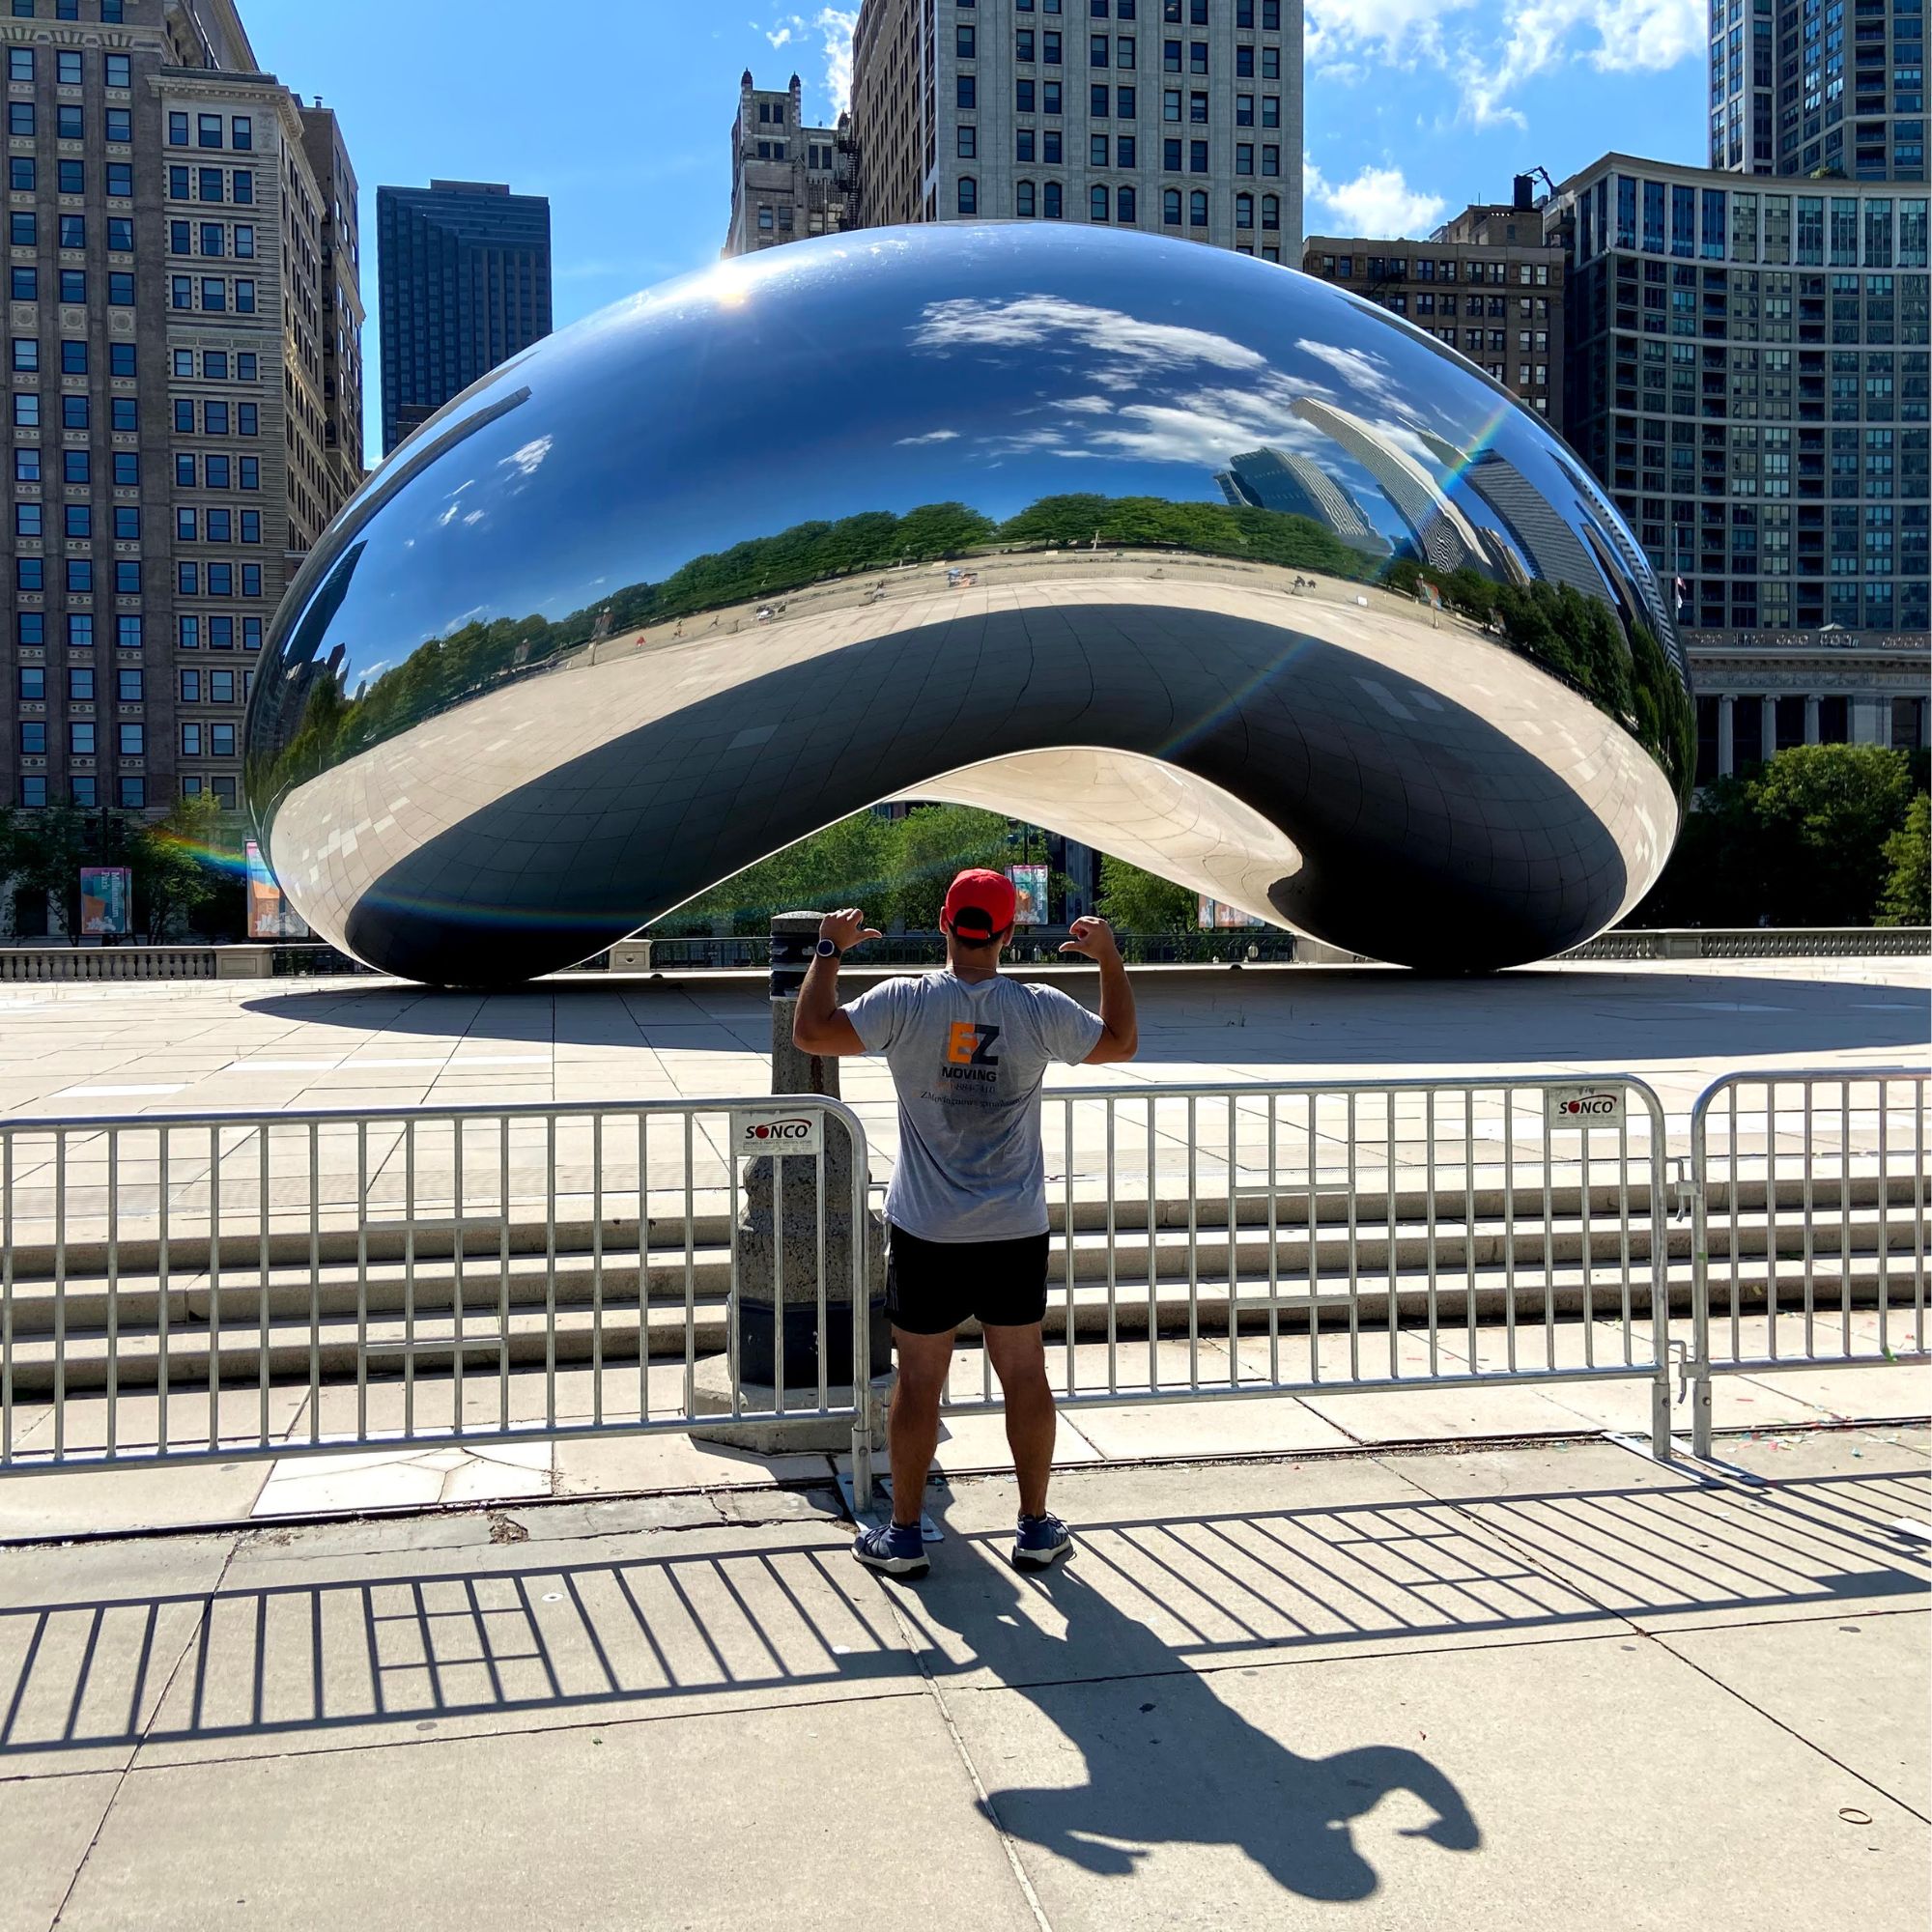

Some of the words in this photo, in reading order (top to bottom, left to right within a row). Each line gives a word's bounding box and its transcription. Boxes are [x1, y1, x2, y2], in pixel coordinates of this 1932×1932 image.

[100, 871, 110, 890] Park
[111, 871, 121, 918] Millennium
[947, 1021, 1001, 1065] EZ
[941, 1066, 997, 1082] MOVING
[1559, 1100, 1614, 1114] SONCO
[745, 1124, 809, 1139] SONCO
